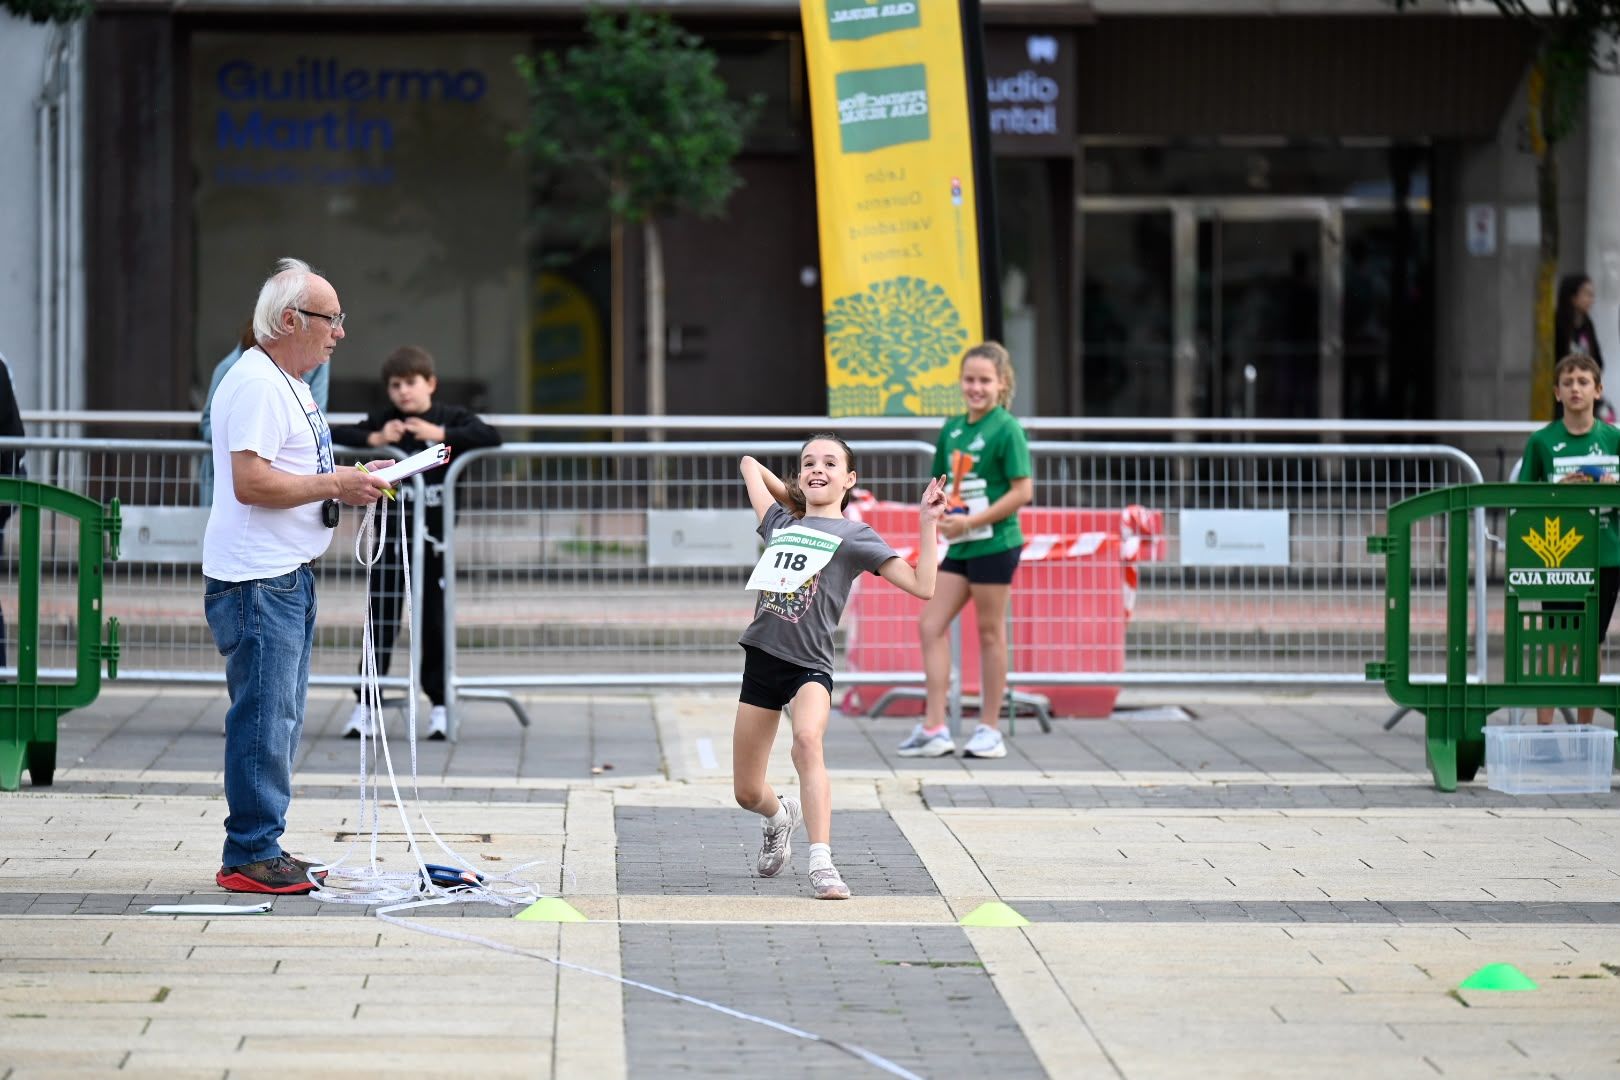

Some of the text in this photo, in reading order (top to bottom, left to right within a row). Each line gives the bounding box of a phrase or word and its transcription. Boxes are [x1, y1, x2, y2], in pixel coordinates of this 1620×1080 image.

[215, 55, 488, 102] Guillermo
[774, 551, 808, 571] 118
[1508, 571, 1595, 585] CAJA RURAL
